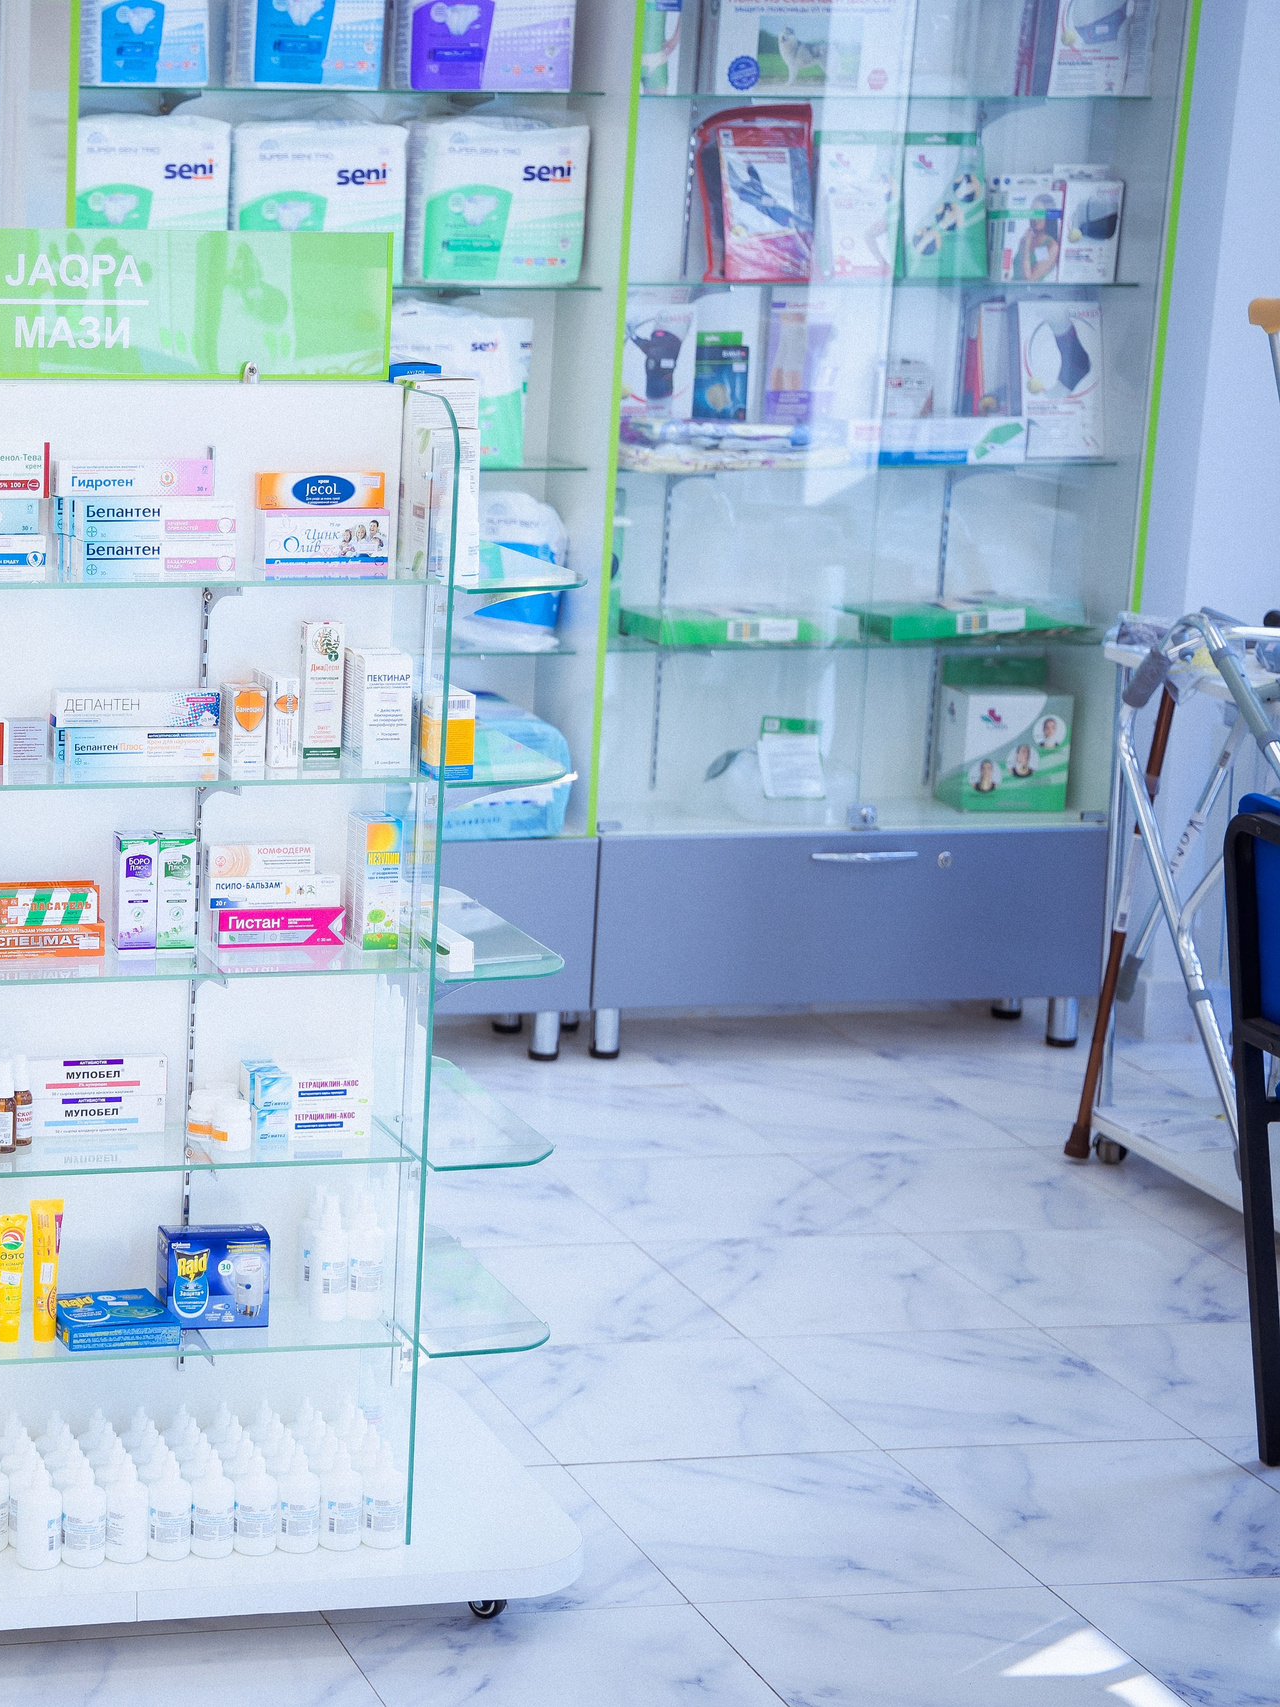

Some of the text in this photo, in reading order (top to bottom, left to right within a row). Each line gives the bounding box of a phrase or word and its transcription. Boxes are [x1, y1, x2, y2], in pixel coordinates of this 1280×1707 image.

[164, 158, 214, 180] seni
[336, 162, 388, 185] seni
[523, 160, 572, 182] seni
[5, 253, 143, 289] JAQPA
[14, 315, 130, 349] МАЗИ
[71, 476, 133, 490] Гидротен
[86, 505, 160, 518] Бепантен
[305, 529, 340, 543] Цинк
[86, 543, 160, 556] Бепантен
[283, 535, 321, 553] Олив
[311, 663, 340, 672] ДиаДерм
[63, 698, 140, 713] ДЕПАНТЕН
[74, 743, 143, 752] Бепантен Плюс
[257, 847, 311, 855] КОМФОДЕРМ
[228, 916, 281, 929] Гистан
[66, 1070, 120, 1080] МУПОБЕЛ
[298, 1080, 359, 1089] ТЕТРАЦИКЛИН-АКОС
[65, 1108, 118, 1117] МУПОБЕЛ
[295, 1112, 355, 1121] ТЕТРАЦИКЛИН-АКОС
[178, 1253, 208, 1276] Raid
